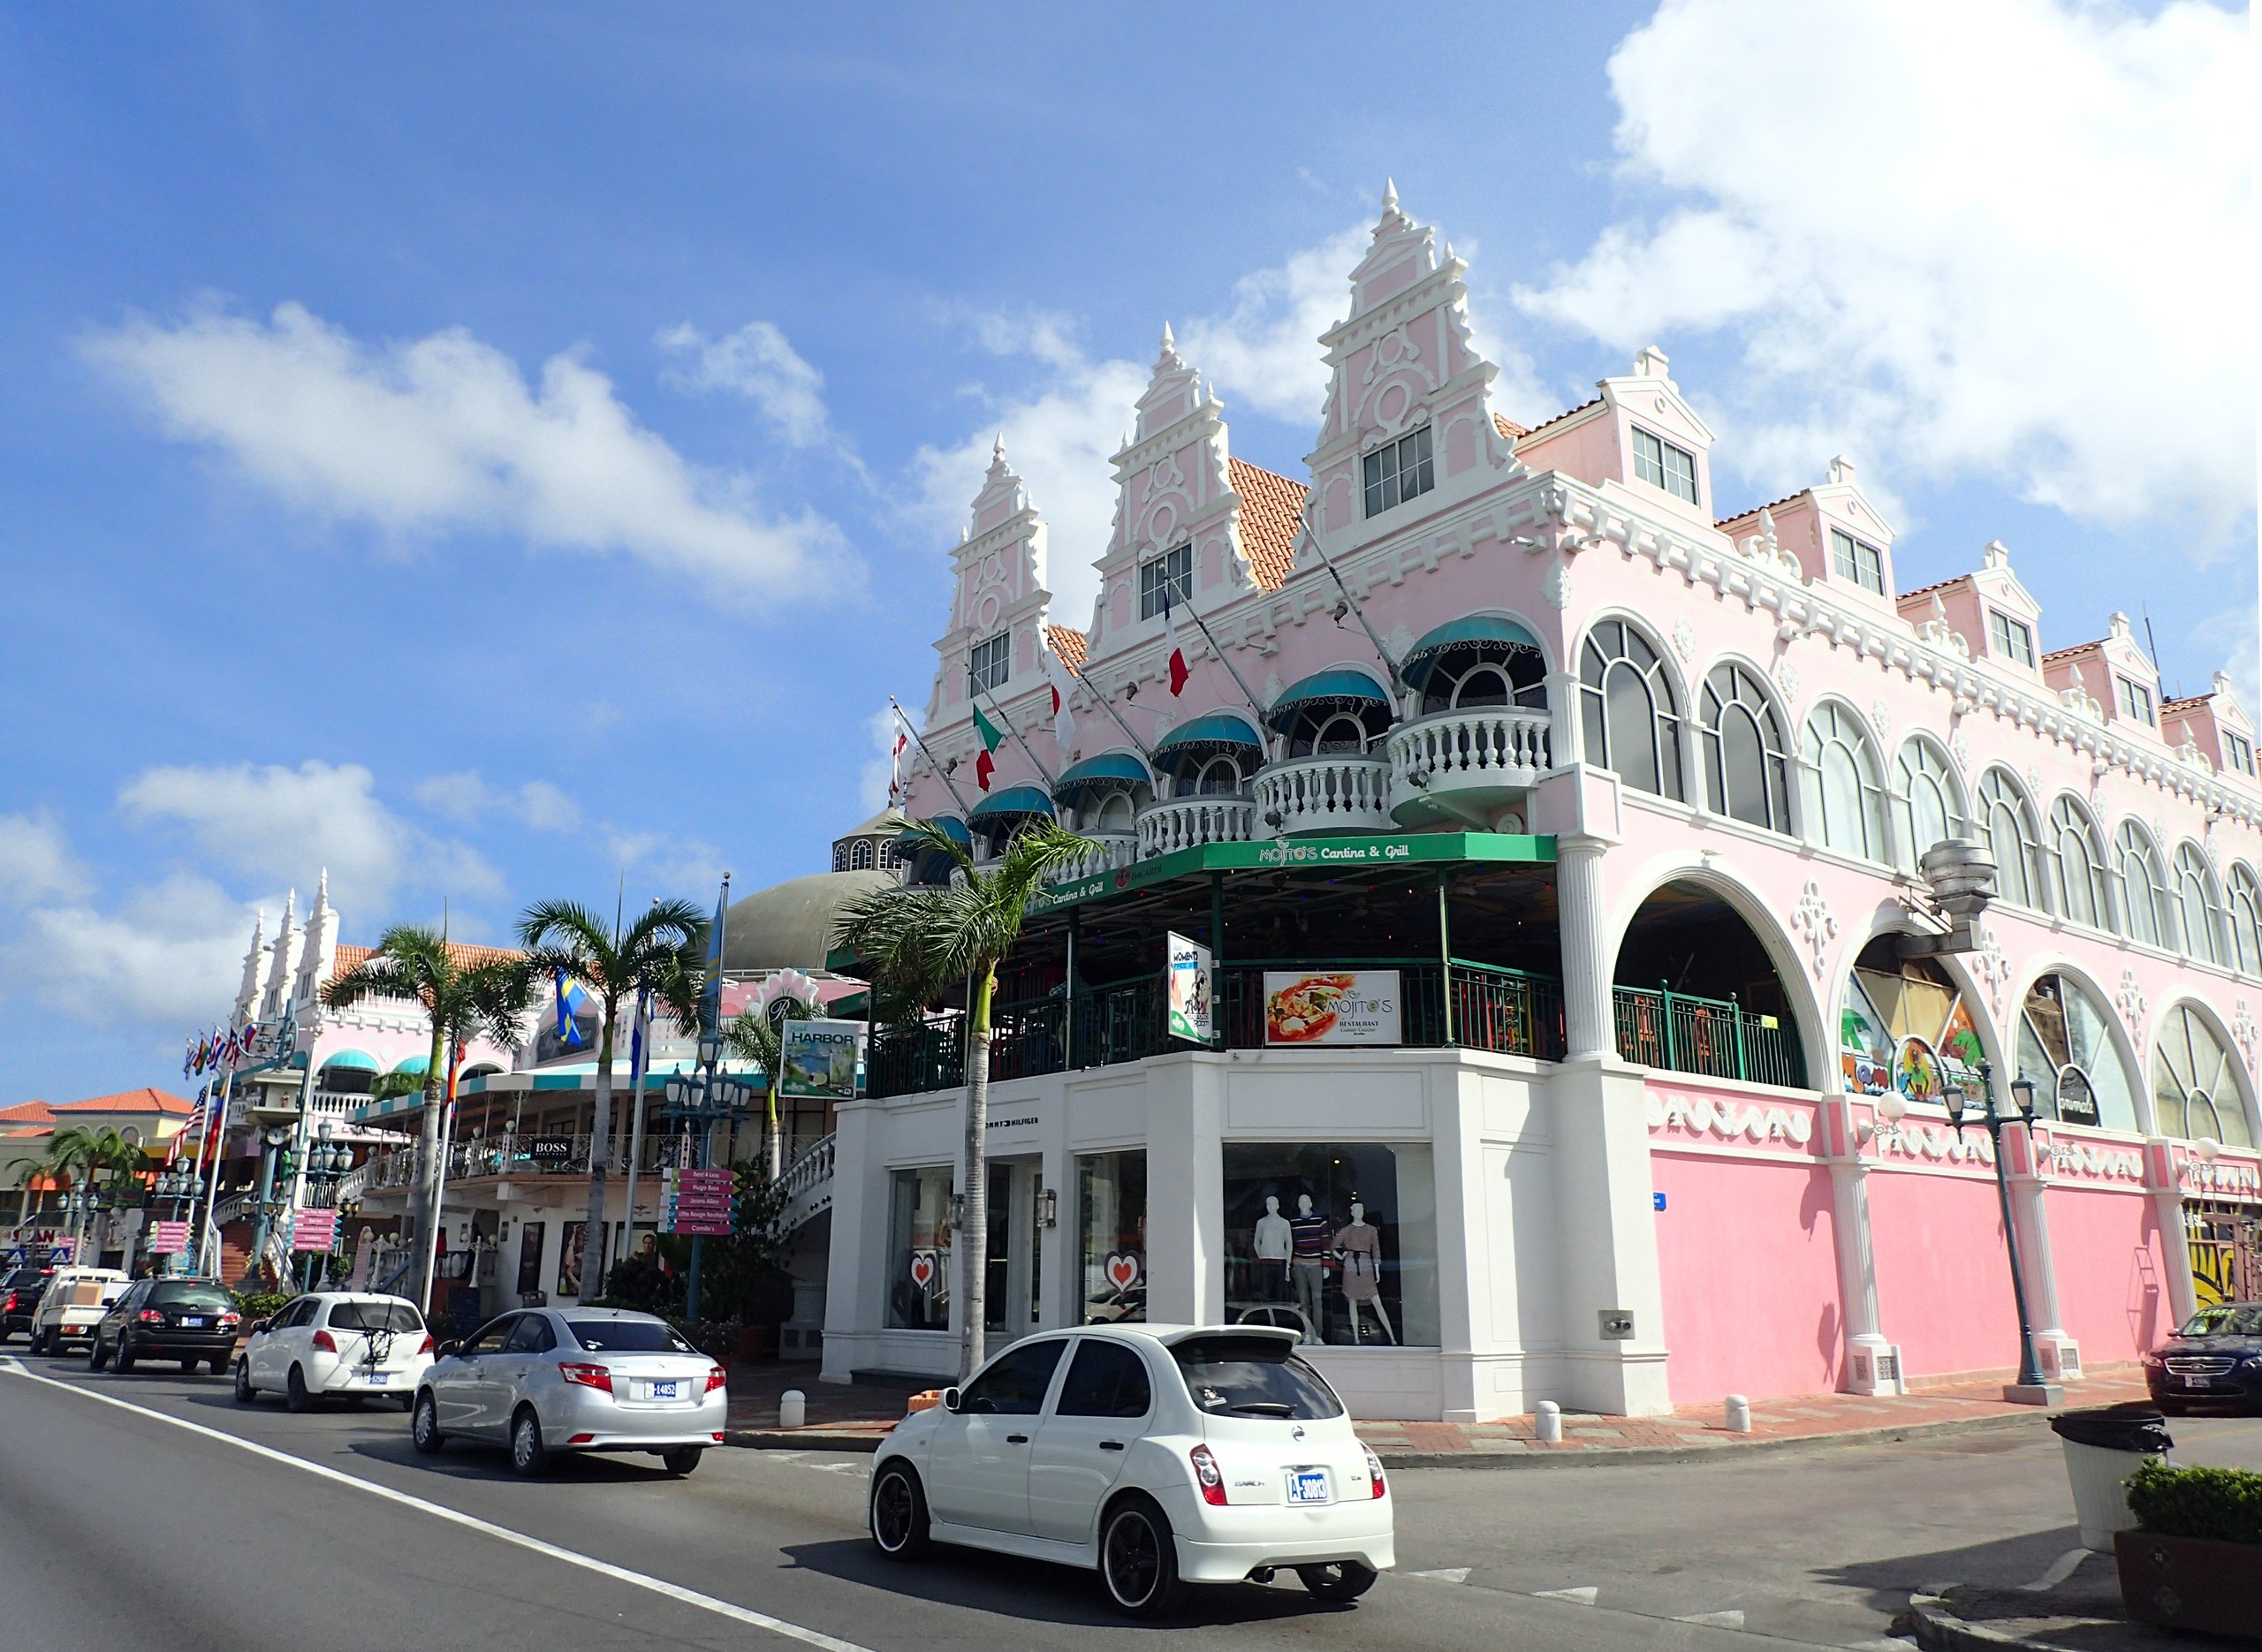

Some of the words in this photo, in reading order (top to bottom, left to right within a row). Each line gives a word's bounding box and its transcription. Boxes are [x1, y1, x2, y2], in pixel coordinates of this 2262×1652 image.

[1259, 843, 1317, 866] MOJITO'S
[1321, 845, 1365, 859] Cantina
[1370, 845, 1380, 857] &
[1385, 844, 1409, 859] Grill
[1131, 865, 1163, 880] BACARDI
[1052, 890, 1078, 905] Cantina
[1079, 886, 1087, 898] &
[1089, 881, 1104, 896] Grill
[1326, 999, 1393, 1019] MOJITO'S
[792, 1033, 854, 1045] HARBOR
[985, 1120, 1003, 1129] OMMY
[1011, 1118, 1038, 1126] HILFIGER
[535, 1142, 567, 1153] BOSS
